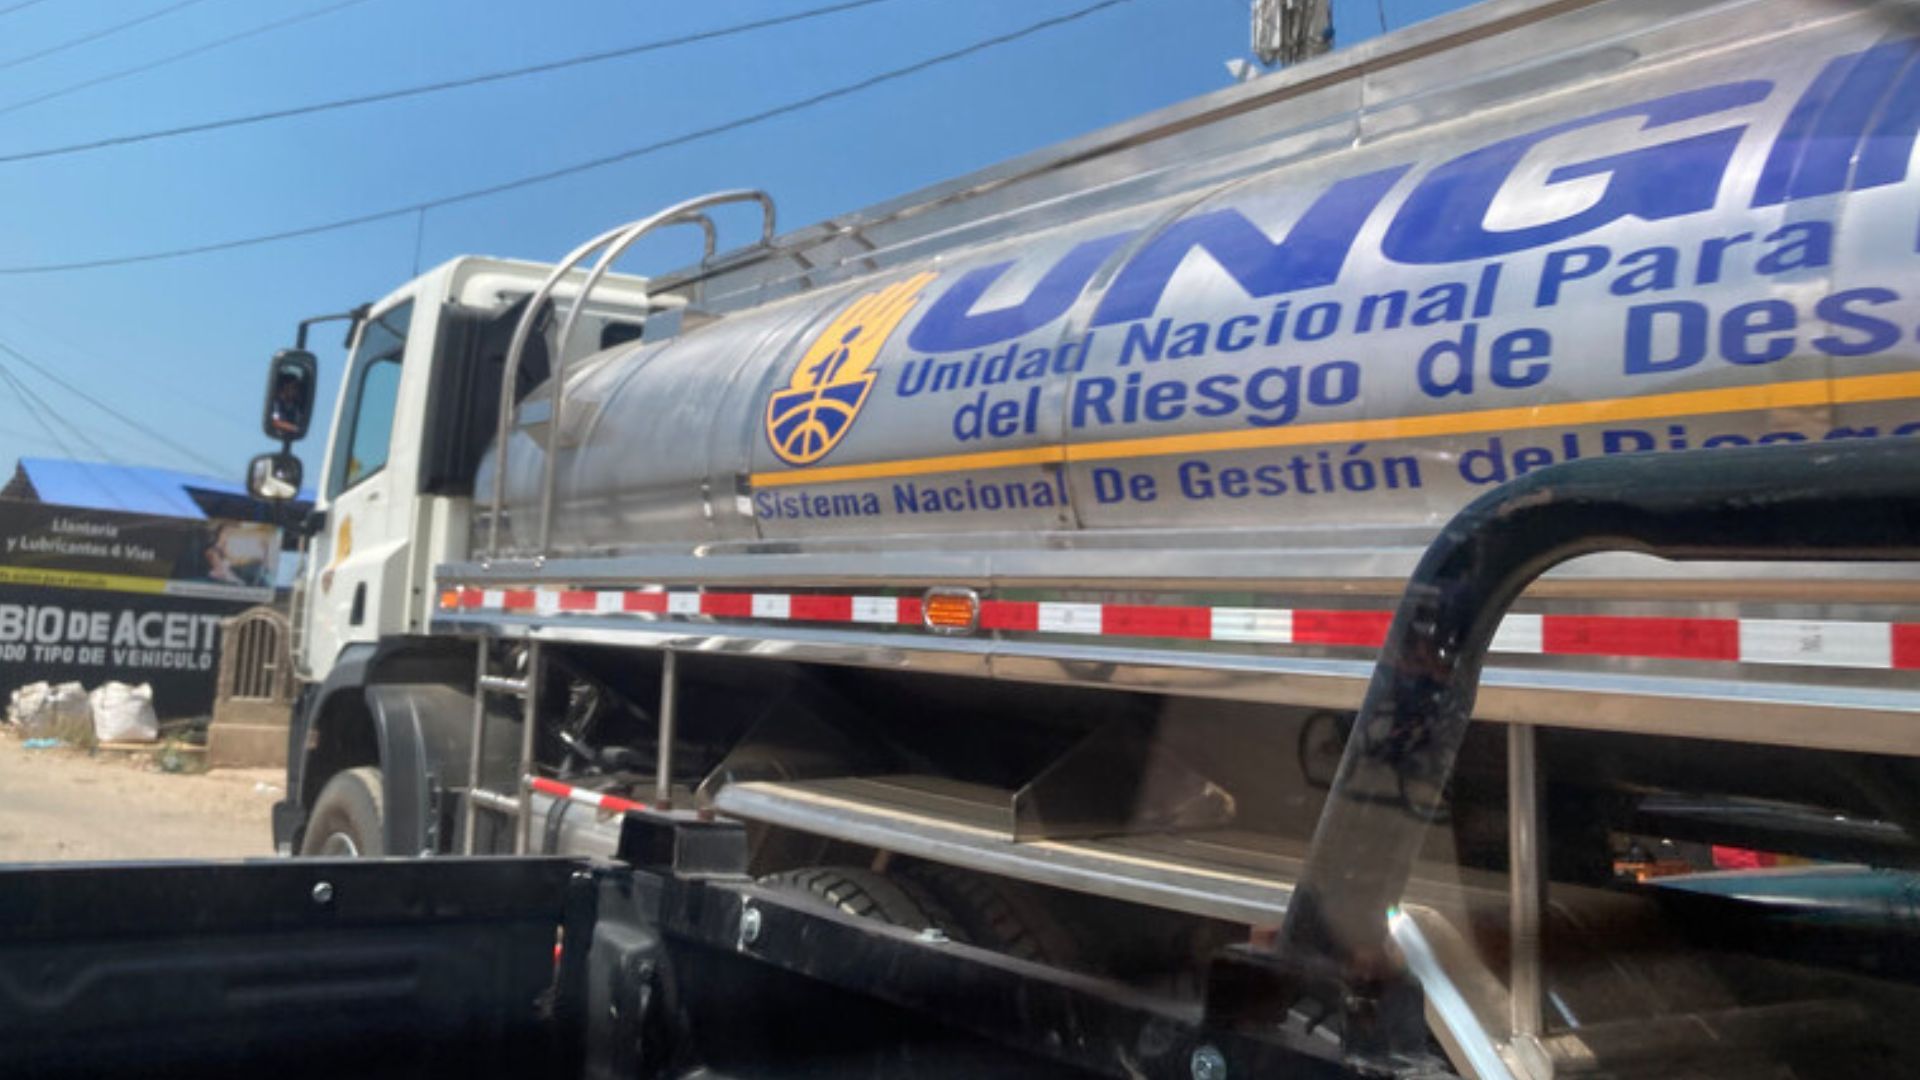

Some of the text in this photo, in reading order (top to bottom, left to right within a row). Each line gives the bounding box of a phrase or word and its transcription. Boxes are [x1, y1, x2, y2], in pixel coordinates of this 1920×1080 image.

[896, 331, 1094, 398] Unidad
[1118, 262, 1503, 367] Nacional
[1535, 220, 1833, 308] Para
[953, 287, 1920, 442] del Riesgo de Des
[755, 486, 881, 521] Sistema
[893, 472, 1068, 516] Nacional
[1092, 466, 1157, 504] De
[1178, 442, 1422, 500] Gestión
[1458, 433, 1580, 485] del
[0, 604, 65, 644] BIO
[67, 610, 111, 643] DE
[33, 644, 75, 665] TIPO
[78, 647, 105, 665] DE
